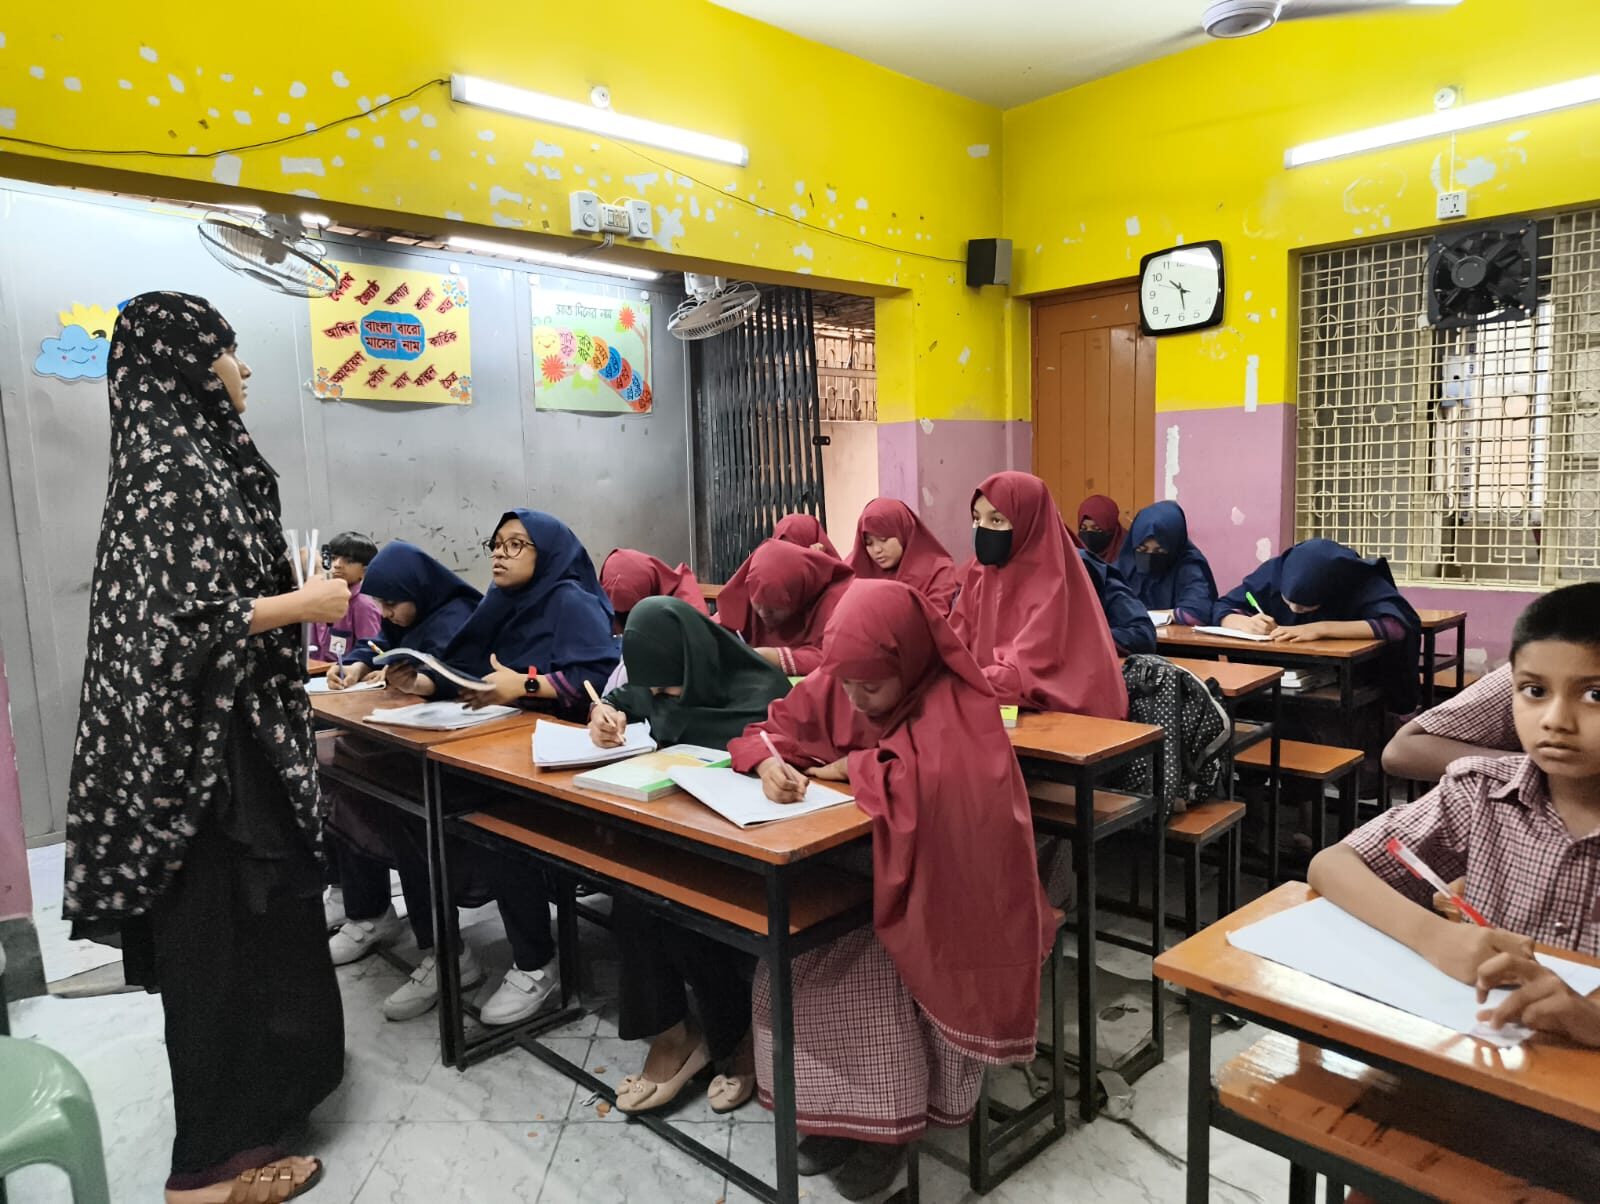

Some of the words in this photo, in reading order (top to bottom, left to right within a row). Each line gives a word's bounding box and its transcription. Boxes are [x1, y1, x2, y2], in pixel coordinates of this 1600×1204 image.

[1163, 261, 1170, 270] 11
[1152, 272, 1163, 282] 10
[1149, 290, 1157, 300] 9
[1152, 306, 1159, 315] 8
[1193, 310, 1201, 319] 5
[1163, 313, 1171, 324] 7
[1178, 312, 1185, 322] 6
[322, 321, 359, 338] আশ্বিন
[363, 320, 392, 335] বাংলা
[395, 323, 421, 337] বারো
[427, 329, 457, 348] কার্তিক
[365, 336, 397, 351] মাসের
[401, 340, 421, 352] নাম
[364, 364, 390, 389] পৌষ
